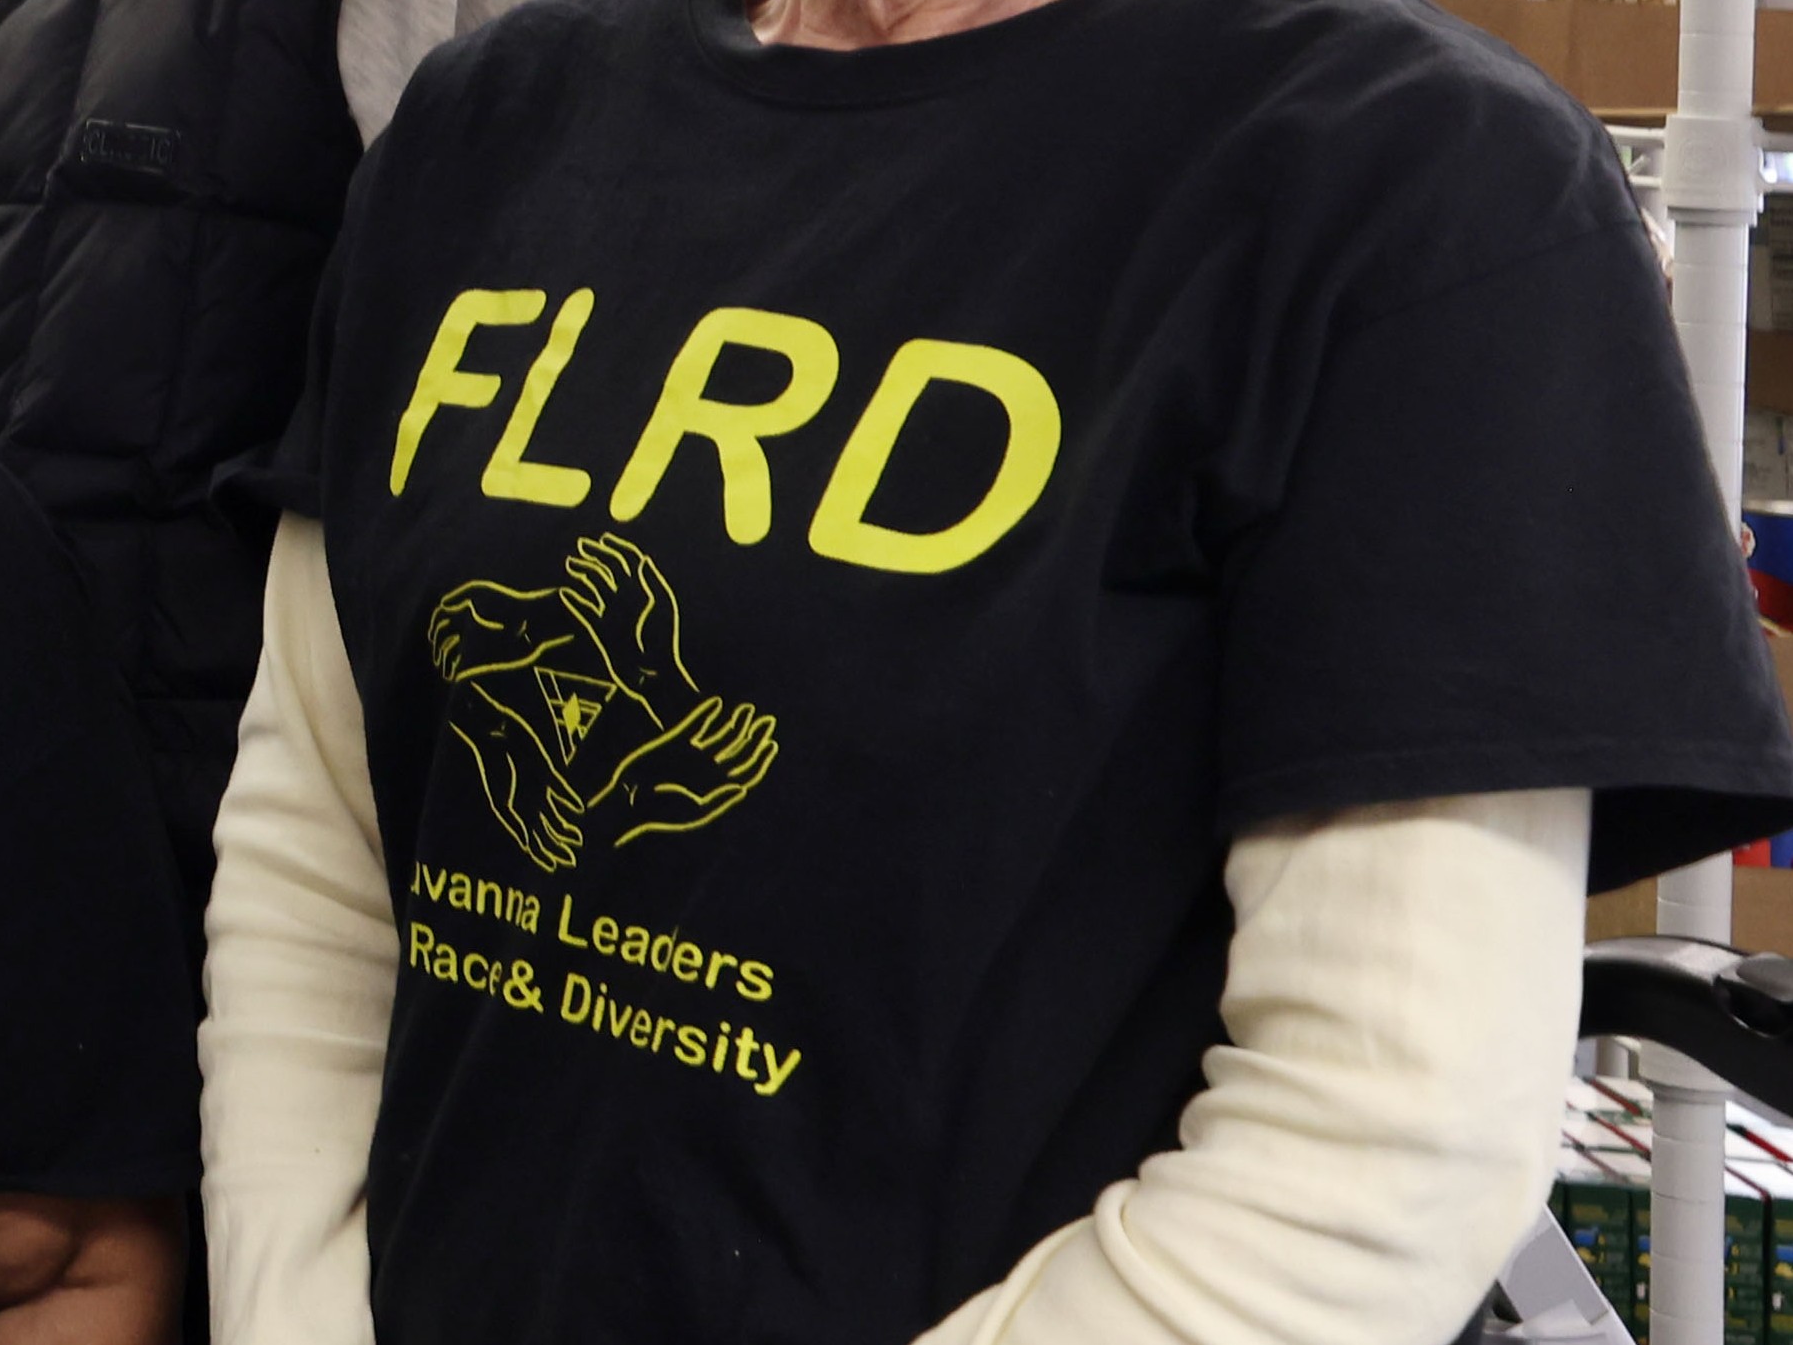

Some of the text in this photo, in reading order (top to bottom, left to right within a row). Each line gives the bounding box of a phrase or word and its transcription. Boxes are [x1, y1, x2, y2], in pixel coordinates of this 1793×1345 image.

[389, 288, 1063, 575] FLRD
[410, 859, 774, 1002] uvanna Leaders
[561, 972, 802, 1097] Diversity
